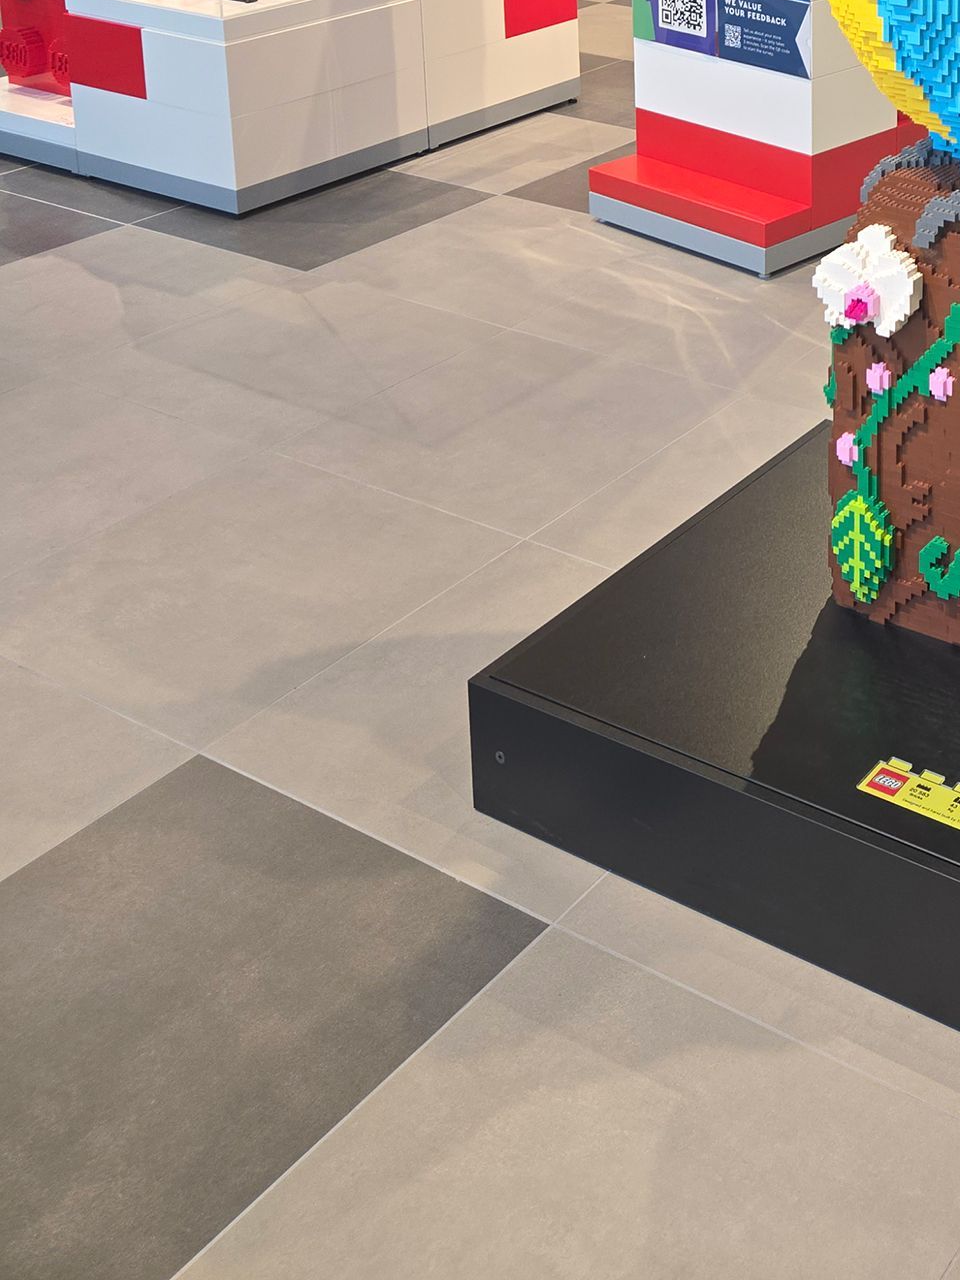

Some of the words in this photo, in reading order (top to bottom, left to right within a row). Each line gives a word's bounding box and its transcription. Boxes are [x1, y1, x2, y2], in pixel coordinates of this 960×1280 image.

[738, 0, 762, 12] VALUE
[724, 6, 745, 17] YOUR
[747, 11, 787, 26] FEEDBACK
[873, 774, 903, 789] LEGO
